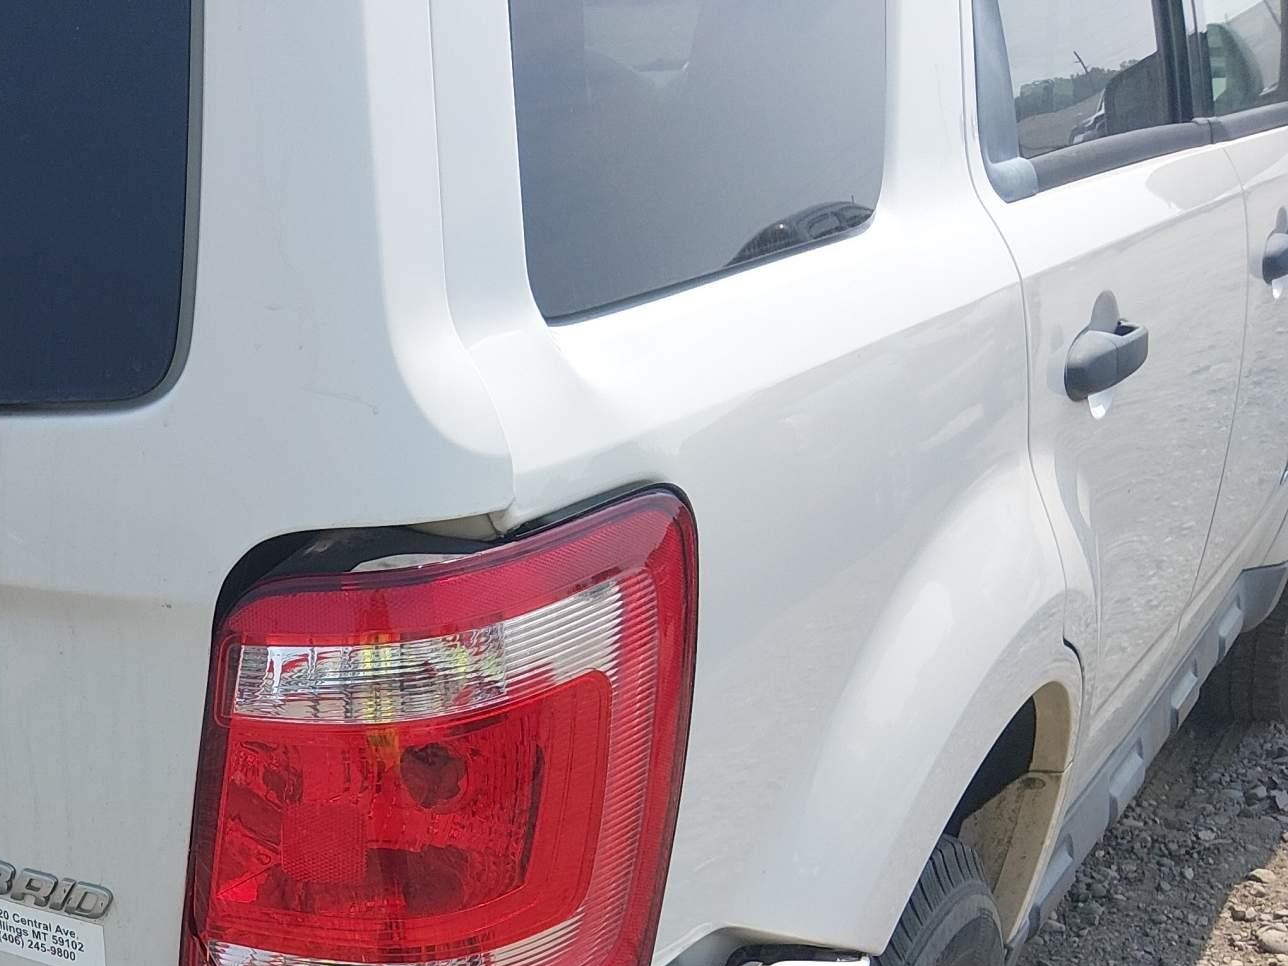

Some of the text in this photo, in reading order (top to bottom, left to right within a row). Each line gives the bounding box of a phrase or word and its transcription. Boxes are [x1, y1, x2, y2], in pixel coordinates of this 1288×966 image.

[12, 912, 52, 932] Central
[55, 923, 80, 939] Ave.
[27, 939, 76, 961] 245-9800
[32, 929, 49, 943] MT
[51, 933, 85, 952] 59102
